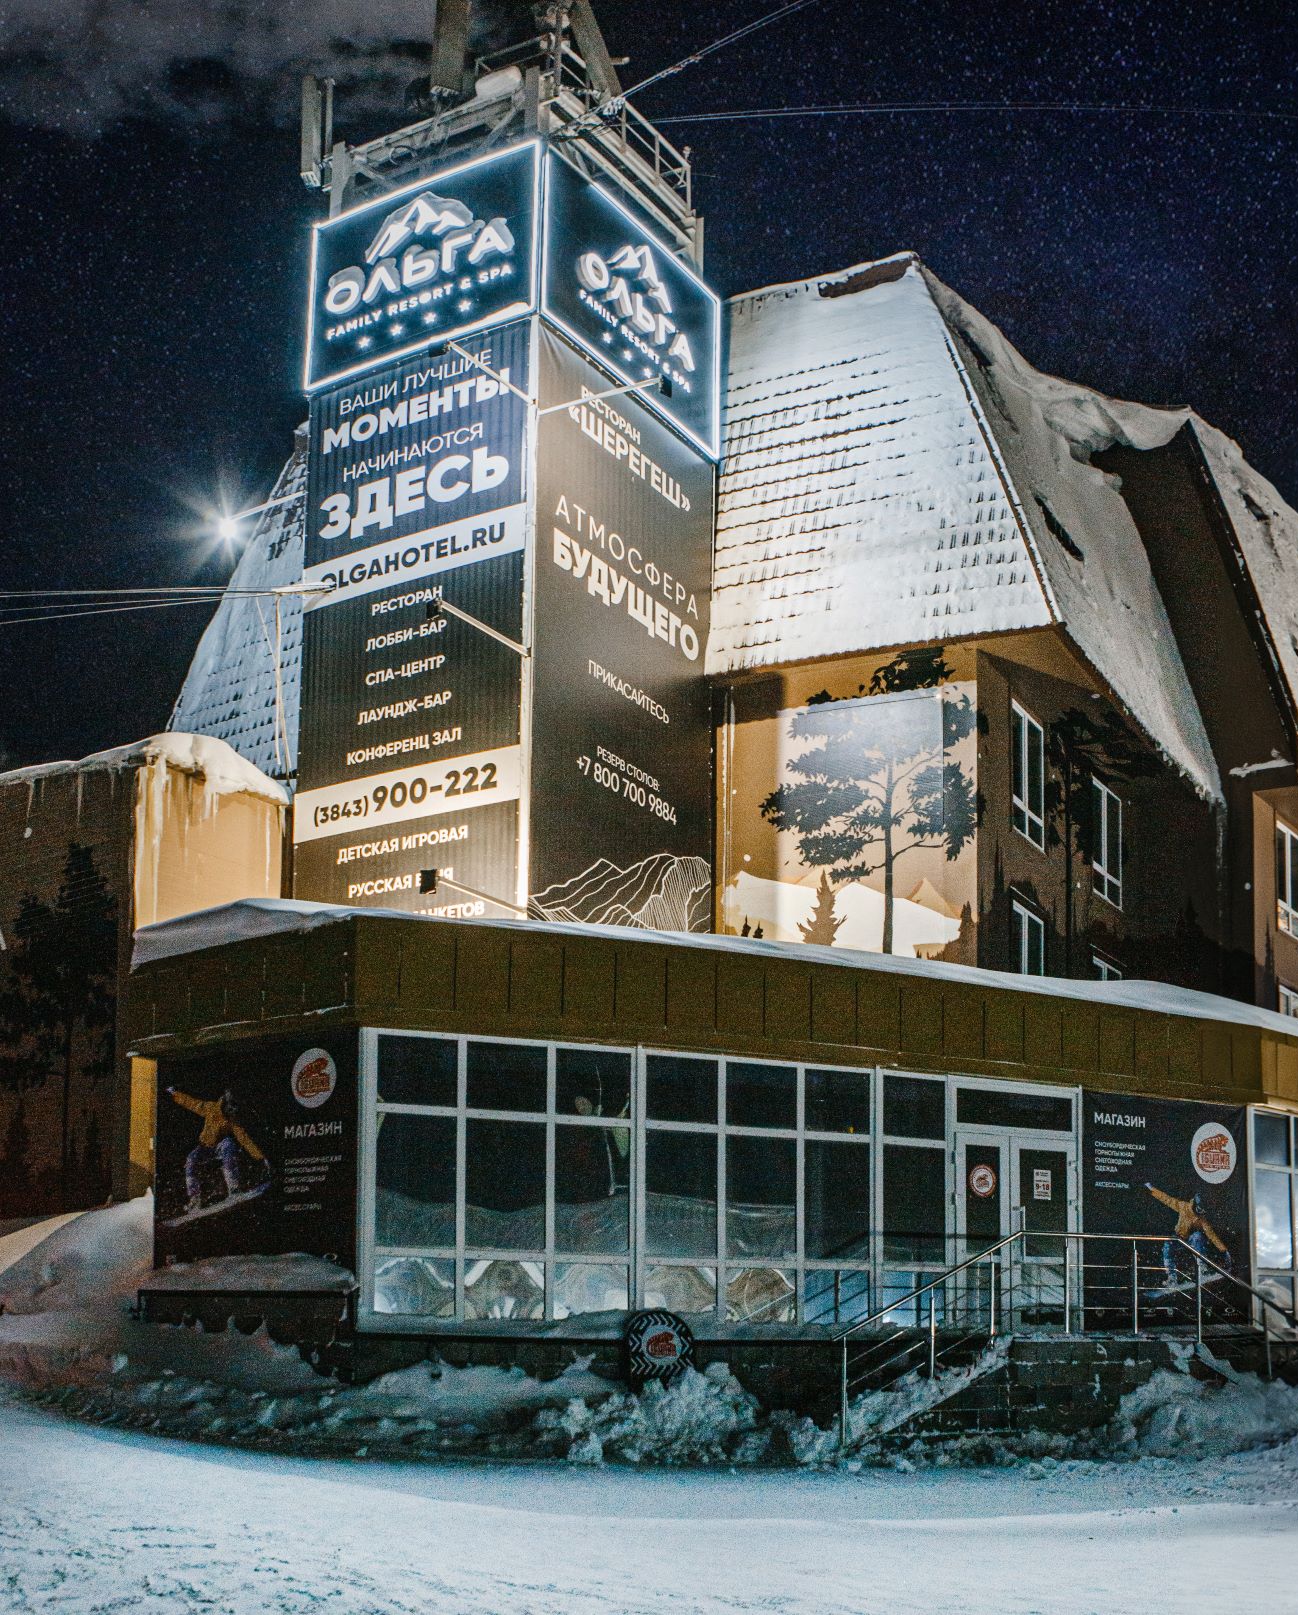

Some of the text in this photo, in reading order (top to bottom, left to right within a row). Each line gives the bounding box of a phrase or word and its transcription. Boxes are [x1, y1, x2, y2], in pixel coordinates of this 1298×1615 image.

[326, 219, 513, 313] ОЛЬГА
[327, 309, 382, 340] FAMILY
[388, 283, 453, 316] RESORT
[478, 263, 512, 284] SPA
[580, 252, 695, 372] ОЛЬГА
[580, 289, 618, 327] FAMILY
[621, 324, 660, 364] RESORT
[673, 370, 691, 393] SPA
[323, 368, 510, 454] МОМЕНТЫ
[340, 349, 492, 415] ВАШИ ЛУЧШИЕ
[343, 422, 484, 482] НАЧИНАЮТСЯ
[568, 404, 692, 512] «ШЕРЕГЕШ»
[319, 446, 510, 540] ЗДЕСЬ
[555, 495, 699, 620] АТМОСФЕРА
[371, 585, 443, 616] РЕСТОРАН
[553, 527, 700, 661] БУДУЩЕГО
[365, 619, 447, 652] ЛОББИ-БАР
[365, 655, 446, 686] СПА-ЦЕНТР
[588, 659, 670, 724] ПРИКАСАЙТЕСЬ
[357, 691, 452, 725] ЛАУНДЖ-БАР
[346, 727, 462, 766] КОНФЕРЕНЦ ЗАЛ
[597, 746, 626, 772] РЕЗЕРВ
[313, 762, 498, 828] (3843) 900-222
[576, 755, 677, 826] +7 800 700 9884
[336, 824, 469, 865] ДЕТСКАЯ ИГРОВАЯ
[347, 873, 413, 899] РУССКАЯ
[284, 1121, 342, 1139] МАГАЗИН
[1094, 1111, 1146, 1128] МАГАЗИН
